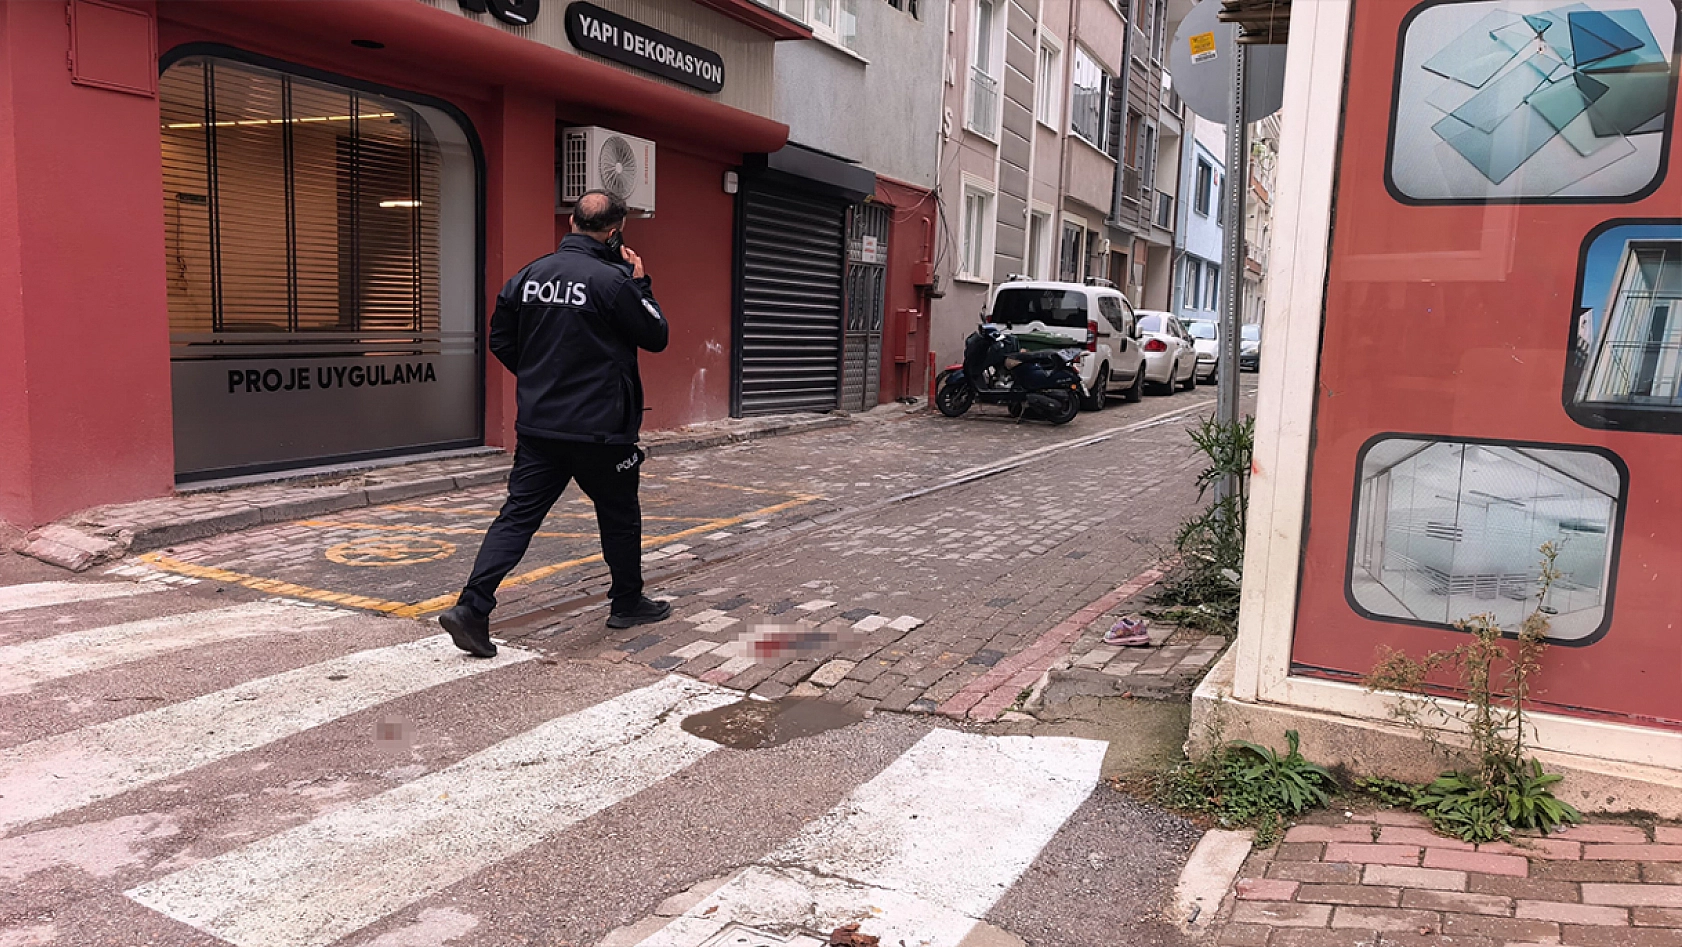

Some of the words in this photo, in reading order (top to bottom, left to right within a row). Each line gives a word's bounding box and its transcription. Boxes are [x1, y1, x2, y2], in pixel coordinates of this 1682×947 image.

[578, 13, 618, 46] YAPI
[623, 31, 721, 84] DEKORASYON
[228, 368, 311, 393] PROJE
[317, 362, 437, 389] UYGULAMA
